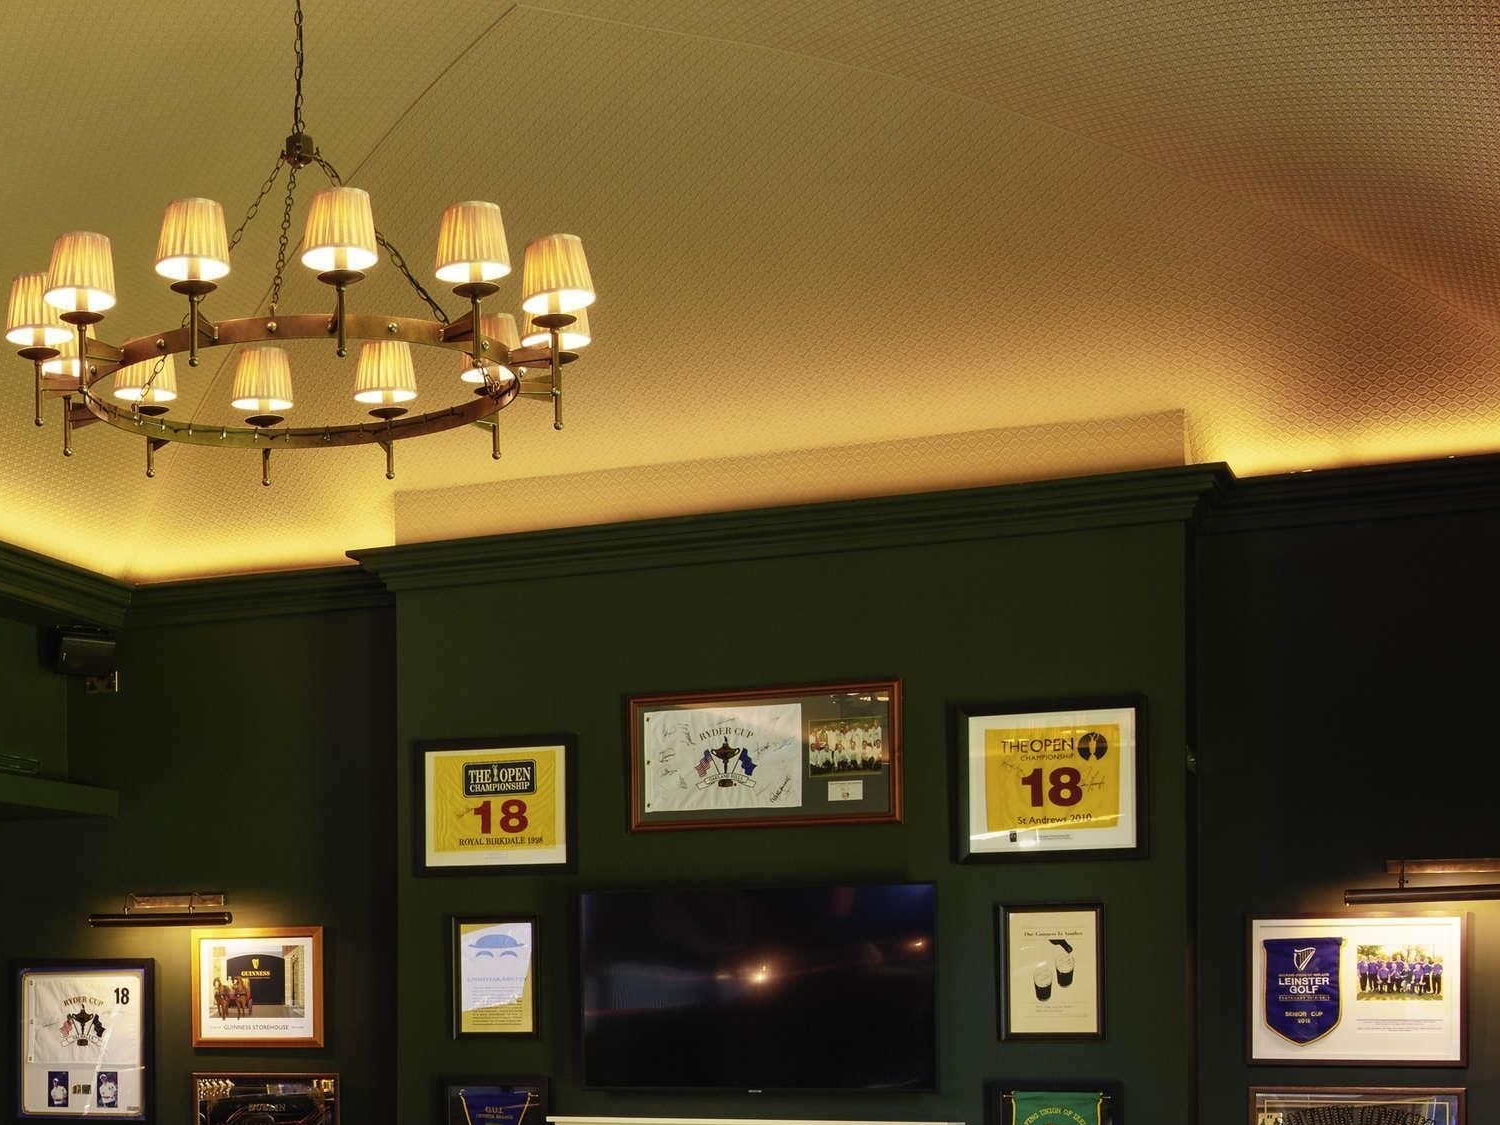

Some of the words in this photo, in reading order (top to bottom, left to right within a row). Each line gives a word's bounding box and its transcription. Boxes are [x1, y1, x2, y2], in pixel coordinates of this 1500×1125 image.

[699, 726, 732, 741] RYDER
[734, 727, 754, 739] CUP
[1020, 753, 1074, 762] CHAMPIONSHIP
[468, 769, 492, 783] THE
[500, 767, 531, 782] OPEN
[469, 781, 530, 793] CHAMPIONSHIP
[1021, 766, 1083, 807] 18
[473, 799, 529, 834] 18
[1017, 816, 1026, 825] St
[1029, 815, 1067, 825] Andrews
[1070, 813, 1092, 823] 2010
[459, 837, 484, 846] ROYAL
[486, 836, 525, 846] BIRKDALE
[1278, 977, 1330, 986] LEINSTER
[1289, 985, 1319, 994] GOLF
[63, 996, 88, 1007] RYDER
[89, 996, 104, 1006] CUP
[114, 987, 130, 1005] 18
